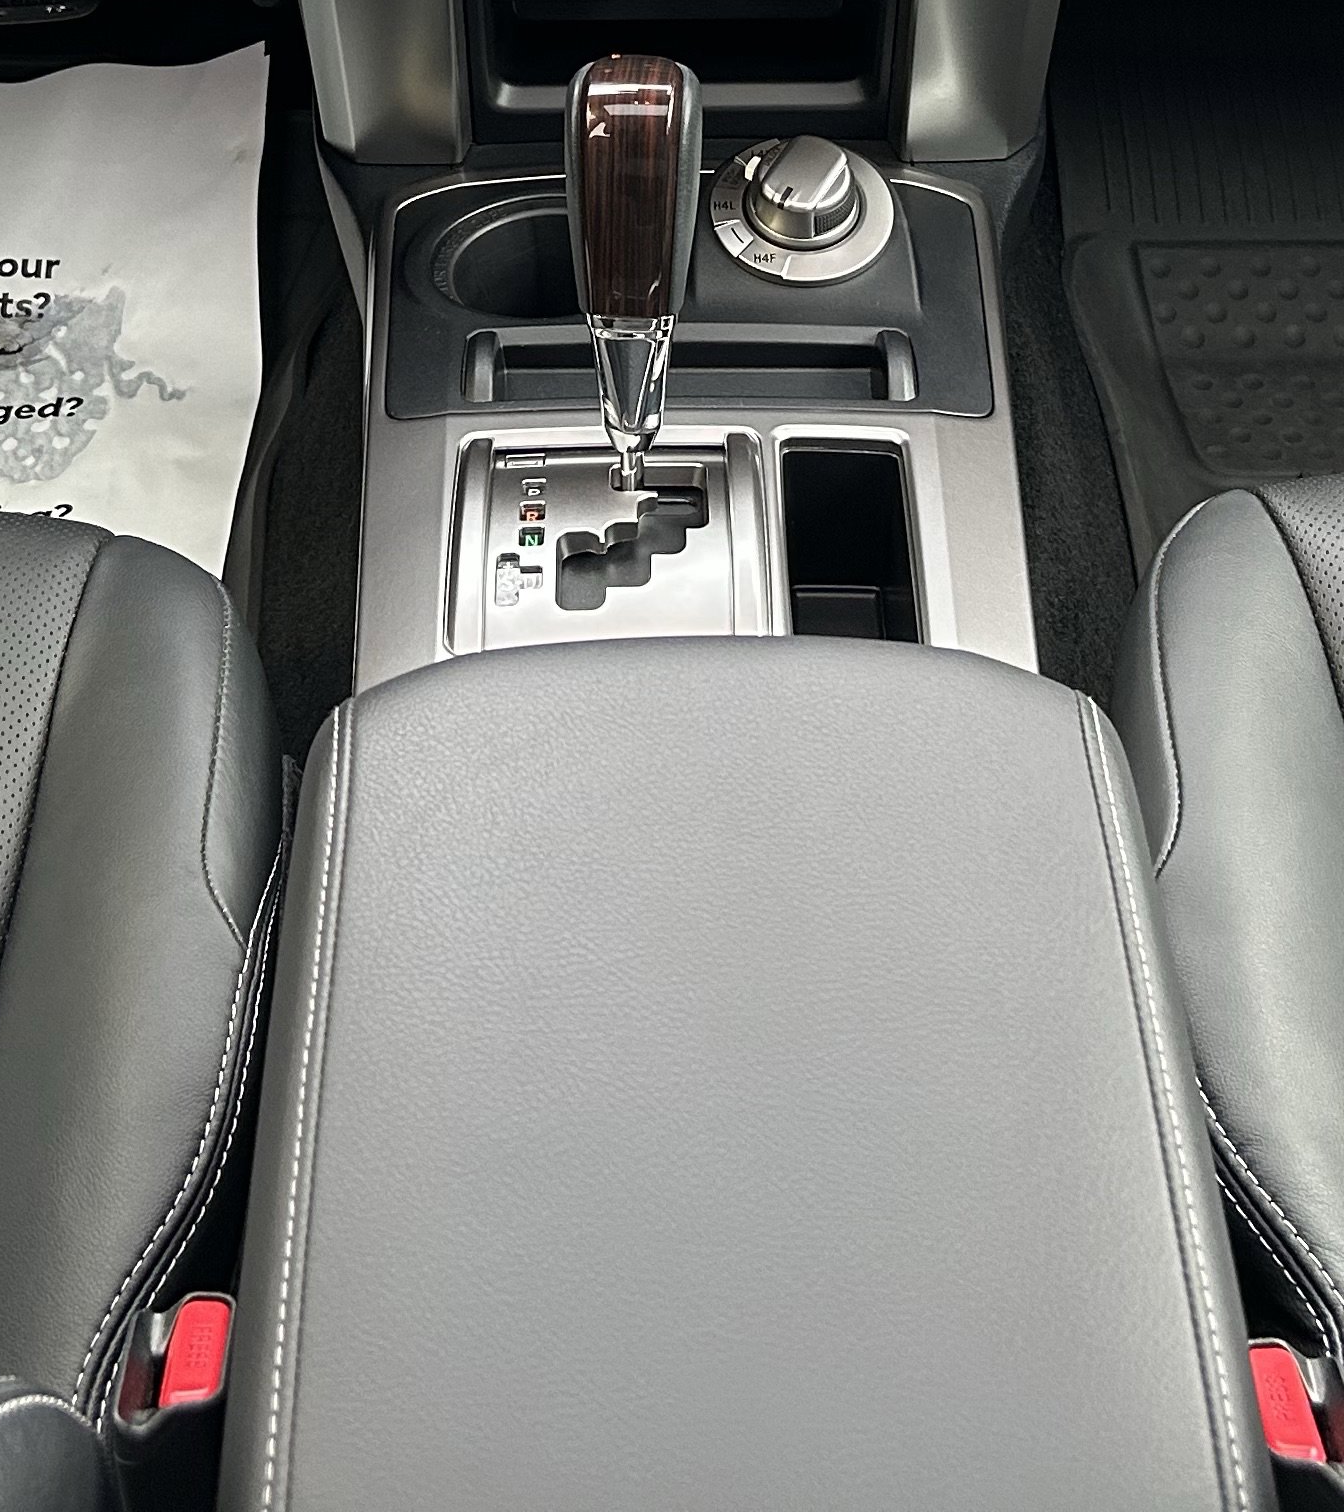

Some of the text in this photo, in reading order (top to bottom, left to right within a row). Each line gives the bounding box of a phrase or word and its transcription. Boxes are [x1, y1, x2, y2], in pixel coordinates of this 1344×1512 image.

[713, 200, 736, 211] H4L
[753, 253, 776, 264] H4F
[525, 534, 538, 546] N
